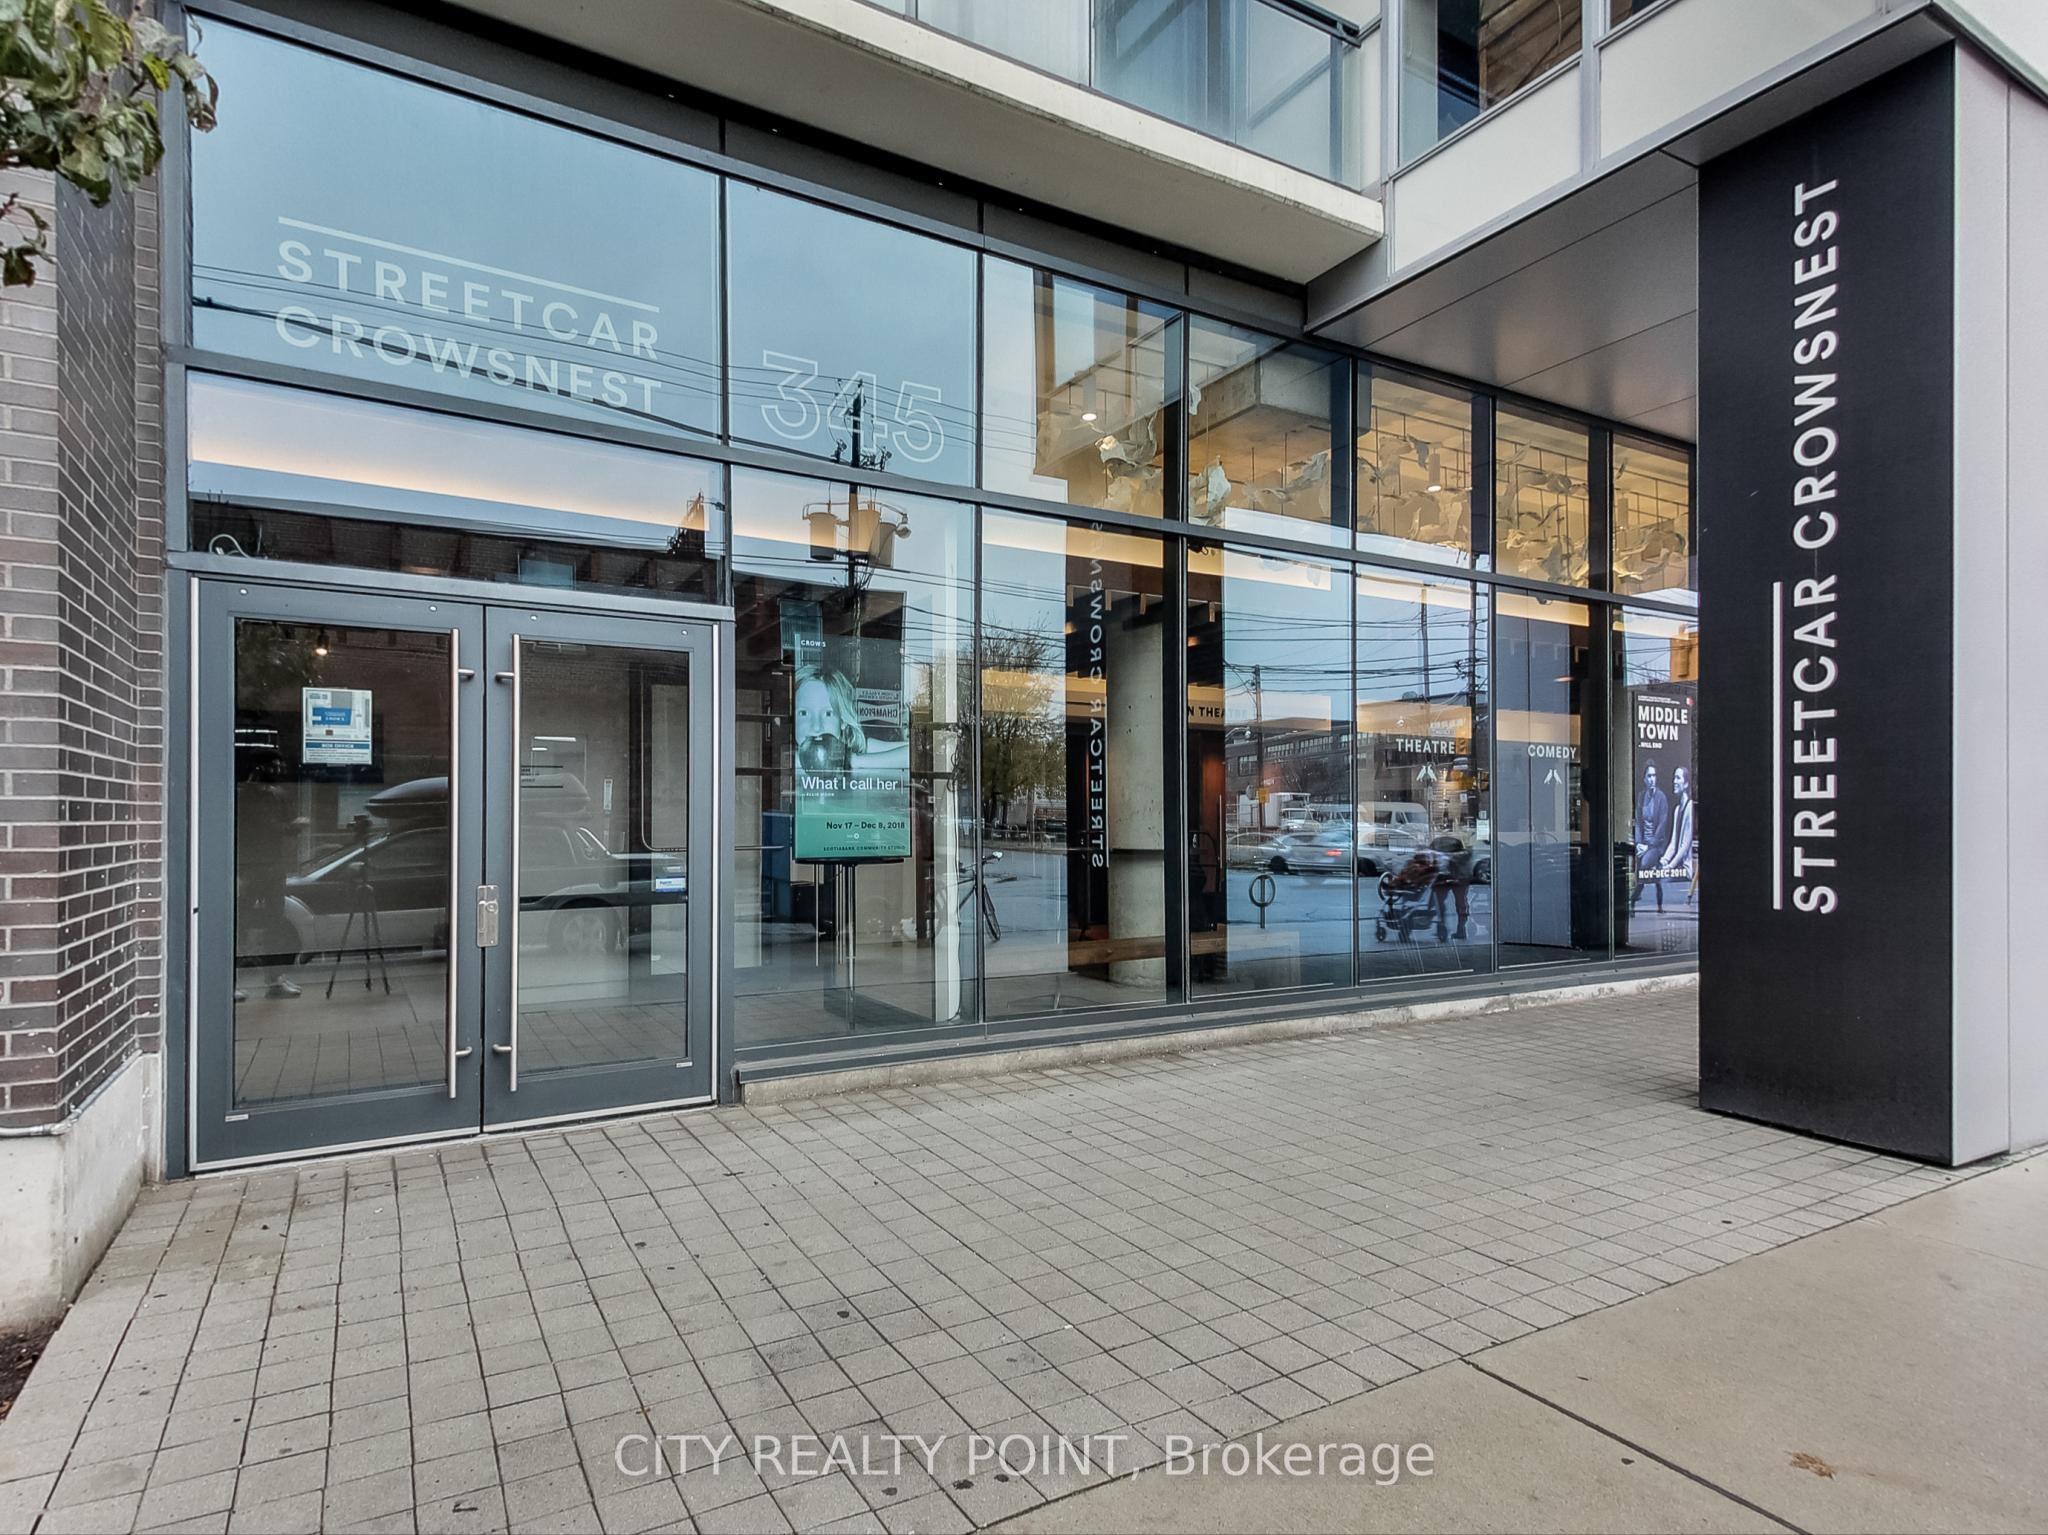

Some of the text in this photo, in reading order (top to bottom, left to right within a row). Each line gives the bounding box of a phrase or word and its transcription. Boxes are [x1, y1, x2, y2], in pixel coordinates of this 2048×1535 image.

[276, 239, 658, 361] STREETCAR
[275, 305, 662, 415] CROWSNEST
[761, 350, 945, 463] 345
[1792, 179, 1838, 915] STREETCAR CROWSNEST
[1638, 705, 1688, 724] MIDDLE
[1638, 723, 1679, 741] TOWN
[1396, 738, 1455, 755] THEATRE
[1527, 745, 1577, 760] COMEDY
[801, 776, 899, 791] What I call her
[826, 821, 843, 830] Nov
[844, 821, 853, 829] 17
[860, 821, 876, 829] Dec
[887, 821, 905, 829] 2018
[1638, 869, 1669, 879] NOV-DEC
